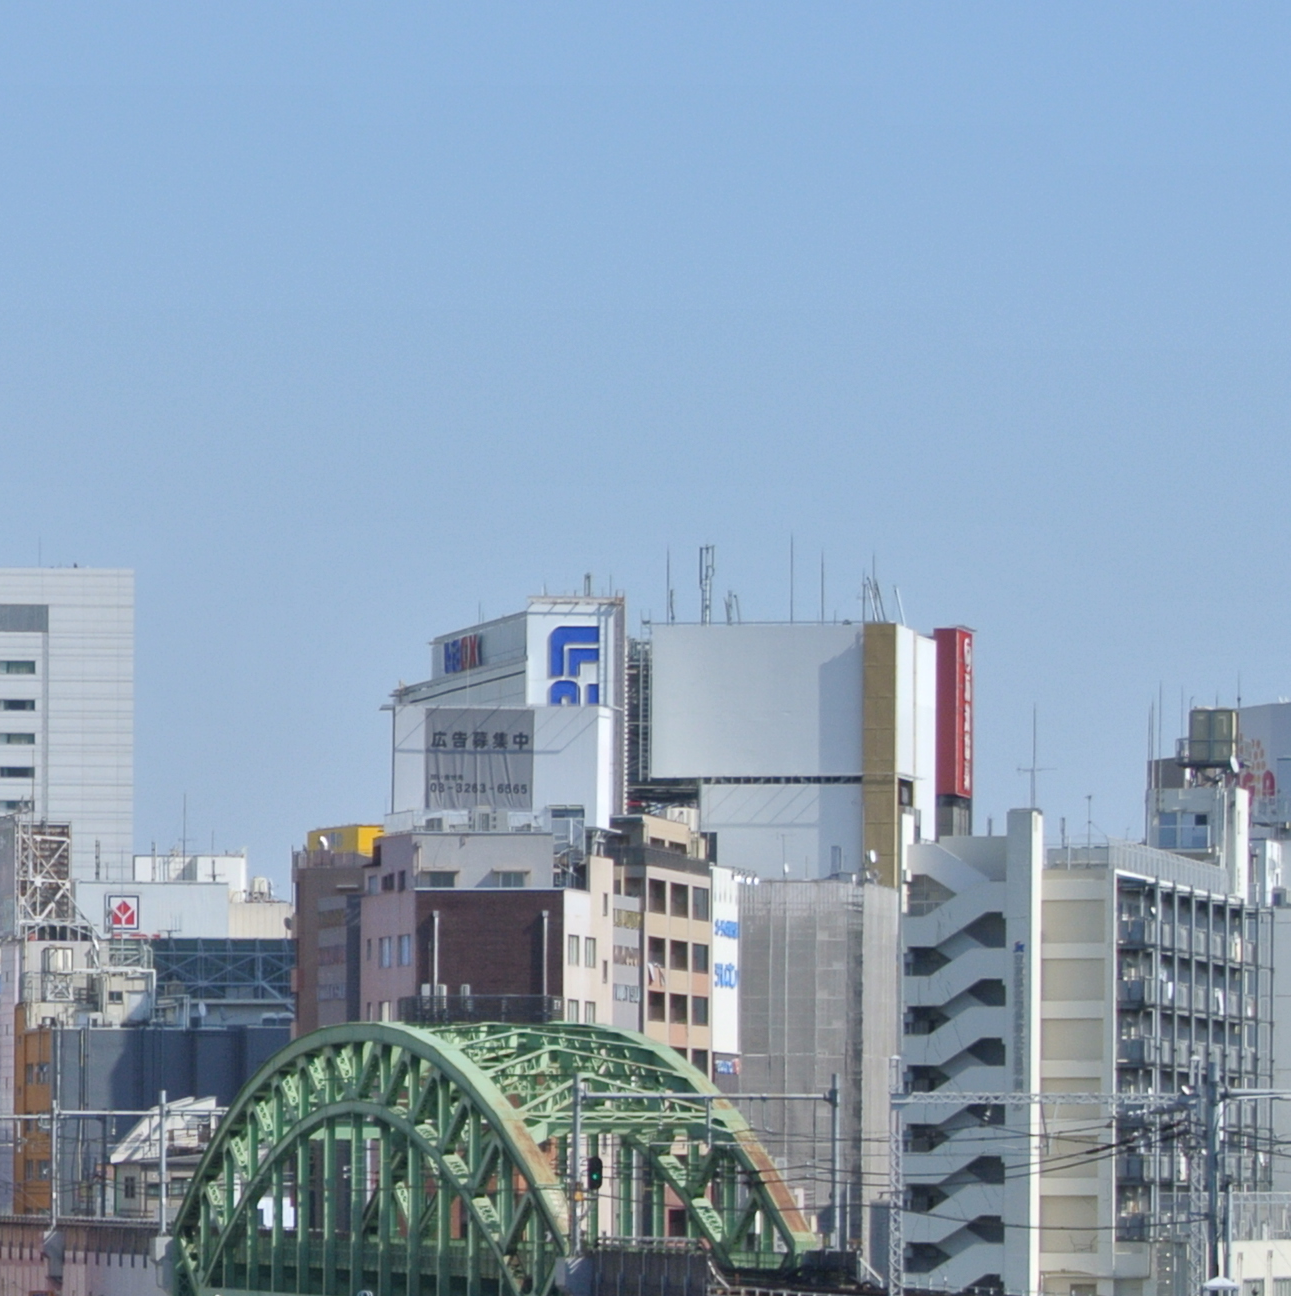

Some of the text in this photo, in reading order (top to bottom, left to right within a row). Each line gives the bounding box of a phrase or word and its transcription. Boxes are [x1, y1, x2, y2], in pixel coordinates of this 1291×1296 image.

[431, 731, 529, 750] 広告募集中
